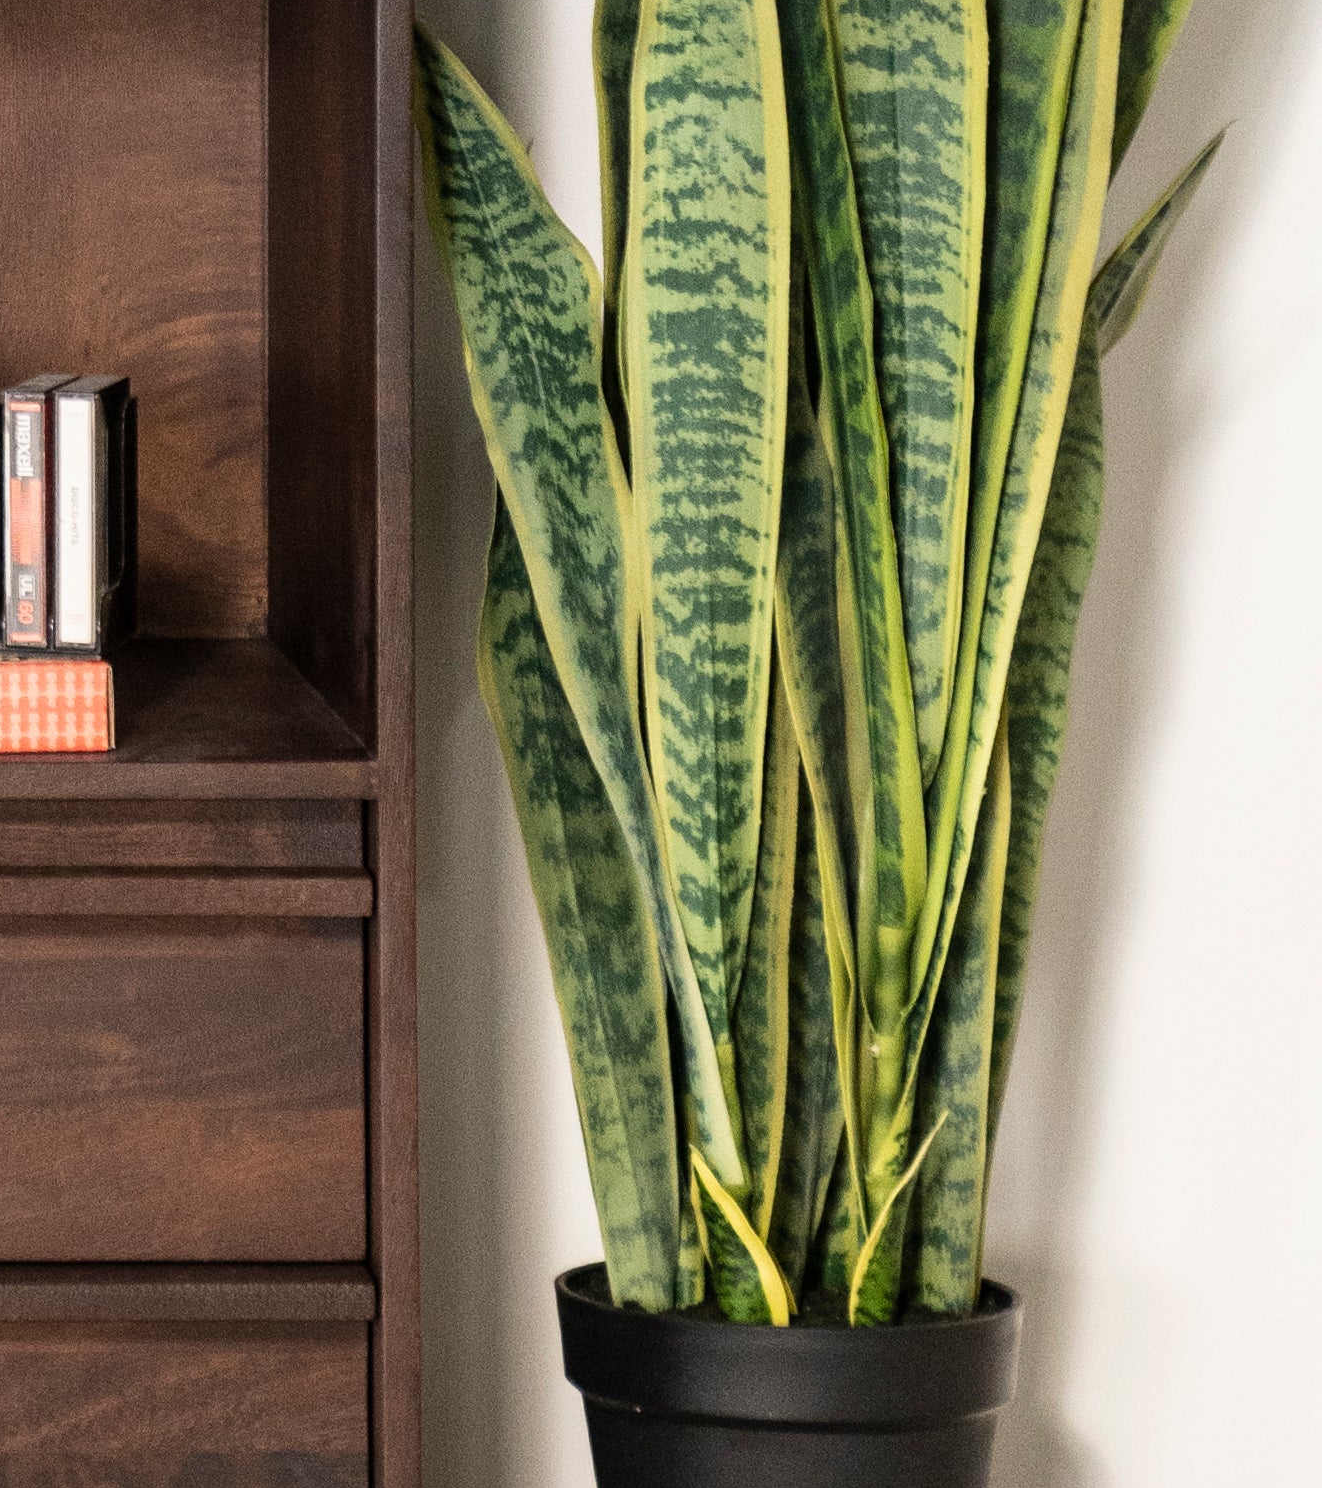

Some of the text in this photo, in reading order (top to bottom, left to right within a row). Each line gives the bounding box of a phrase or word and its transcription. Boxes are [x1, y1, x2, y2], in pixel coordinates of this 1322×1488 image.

[15, 412, 34, 478] maxell
[17, 577, 35, 625] UL 60
